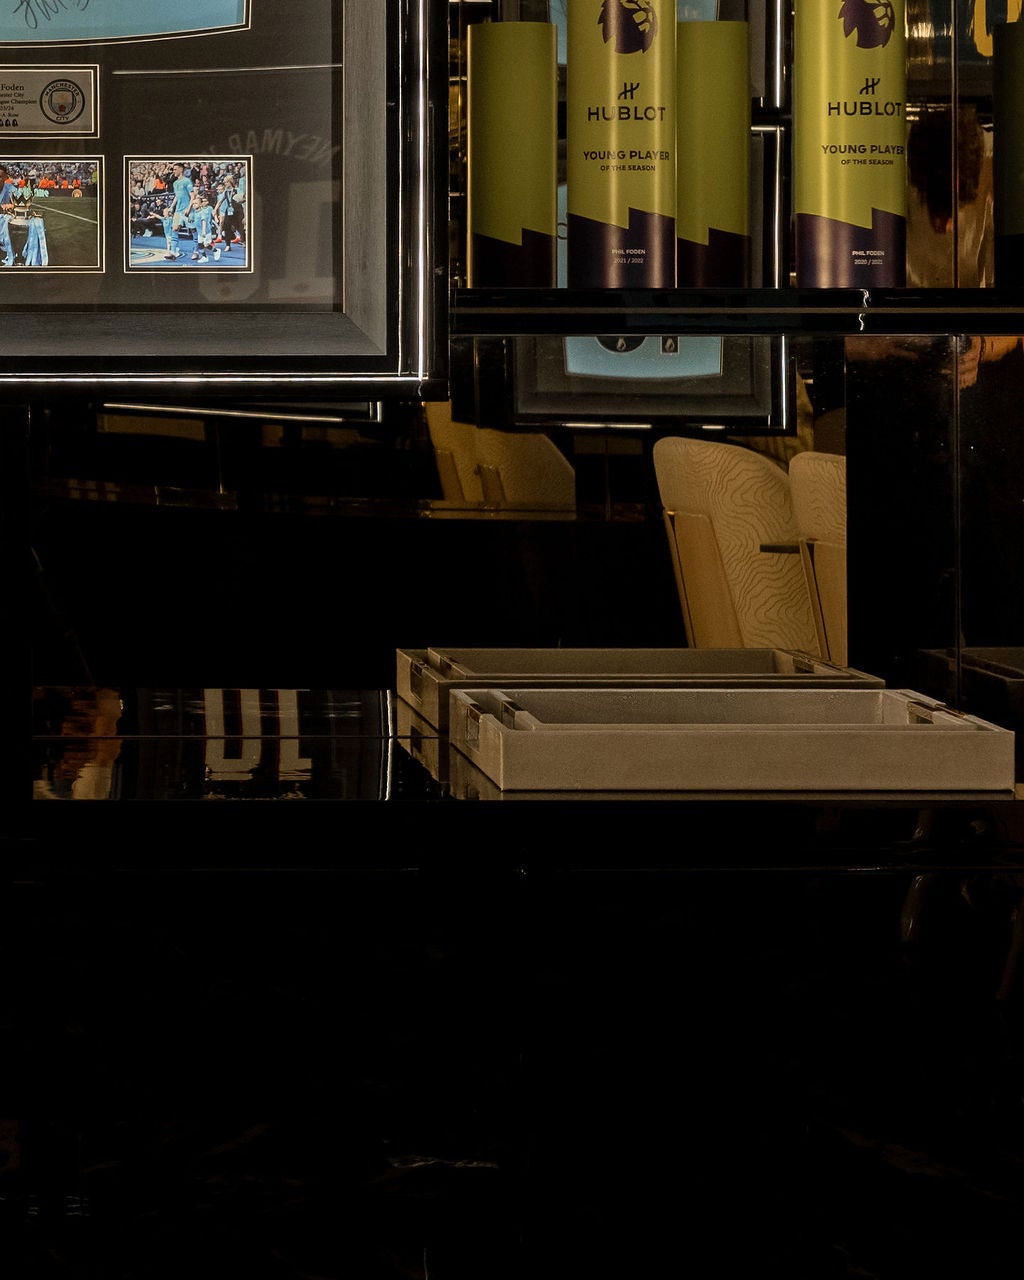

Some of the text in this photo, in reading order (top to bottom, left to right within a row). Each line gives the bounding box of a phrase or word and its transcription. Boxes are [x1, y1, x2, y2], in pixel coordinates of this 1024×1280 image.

[1, 83, 25, 91] Foden
[45, 83, 80, 97] MANCHESTER
[587, 106, 666, 121] HUBLOT
[828, 101, 902, 116] HUBLOT
[583, 150, 670, 160] YOUNG PLAYER
[822, 145, 905, 154] YOUNG PLAYER
